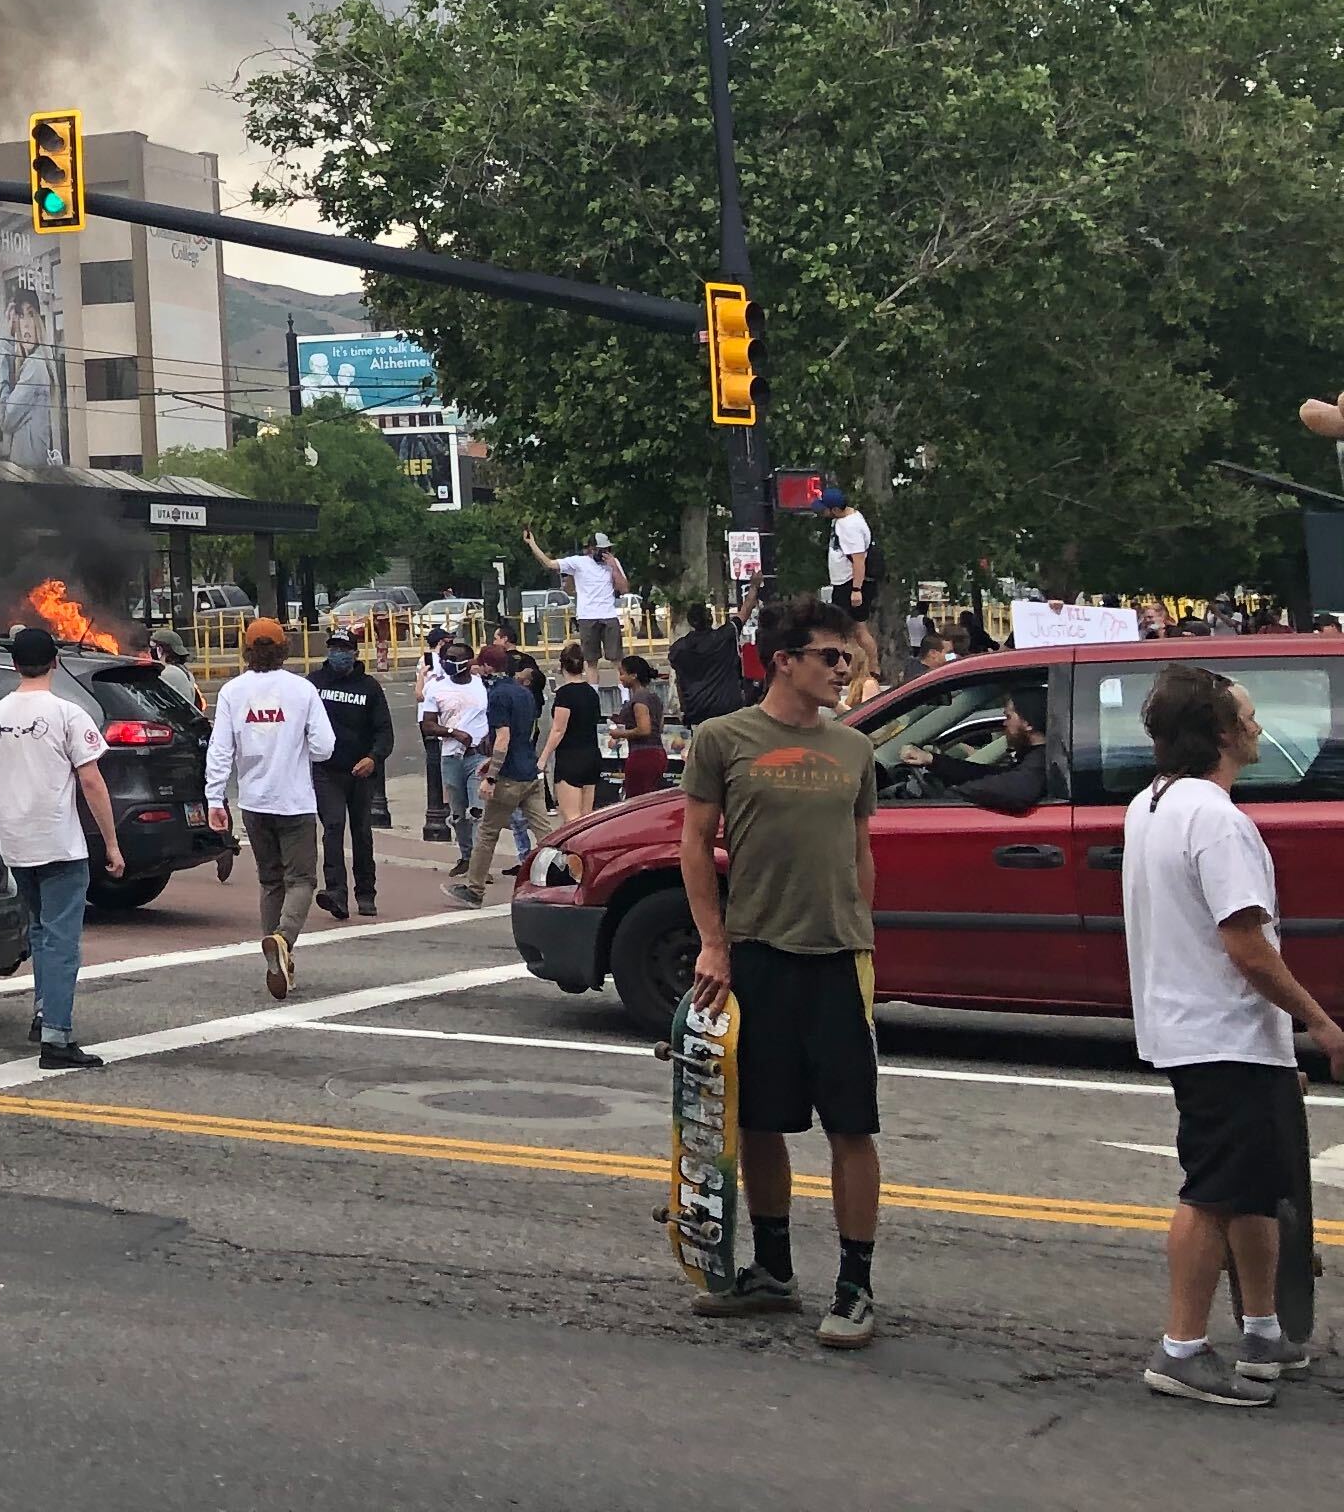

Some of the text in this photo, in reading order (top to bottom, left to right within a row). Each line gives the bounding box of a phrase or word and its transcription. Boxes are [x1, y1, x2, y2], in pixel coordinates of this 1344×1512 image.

[18, 267, 51, 294] HERE
[332, 346, 348, 358] It's
[350, 346, 373, 357] time
[375, 345, 387, 355] to
[388, 342, 408, 354] talk
[158, 509, 200, 520] UTA TRAX
[318, 688, 367, 706] UMERICAN
[245, 707, 286, 723] ALTA
